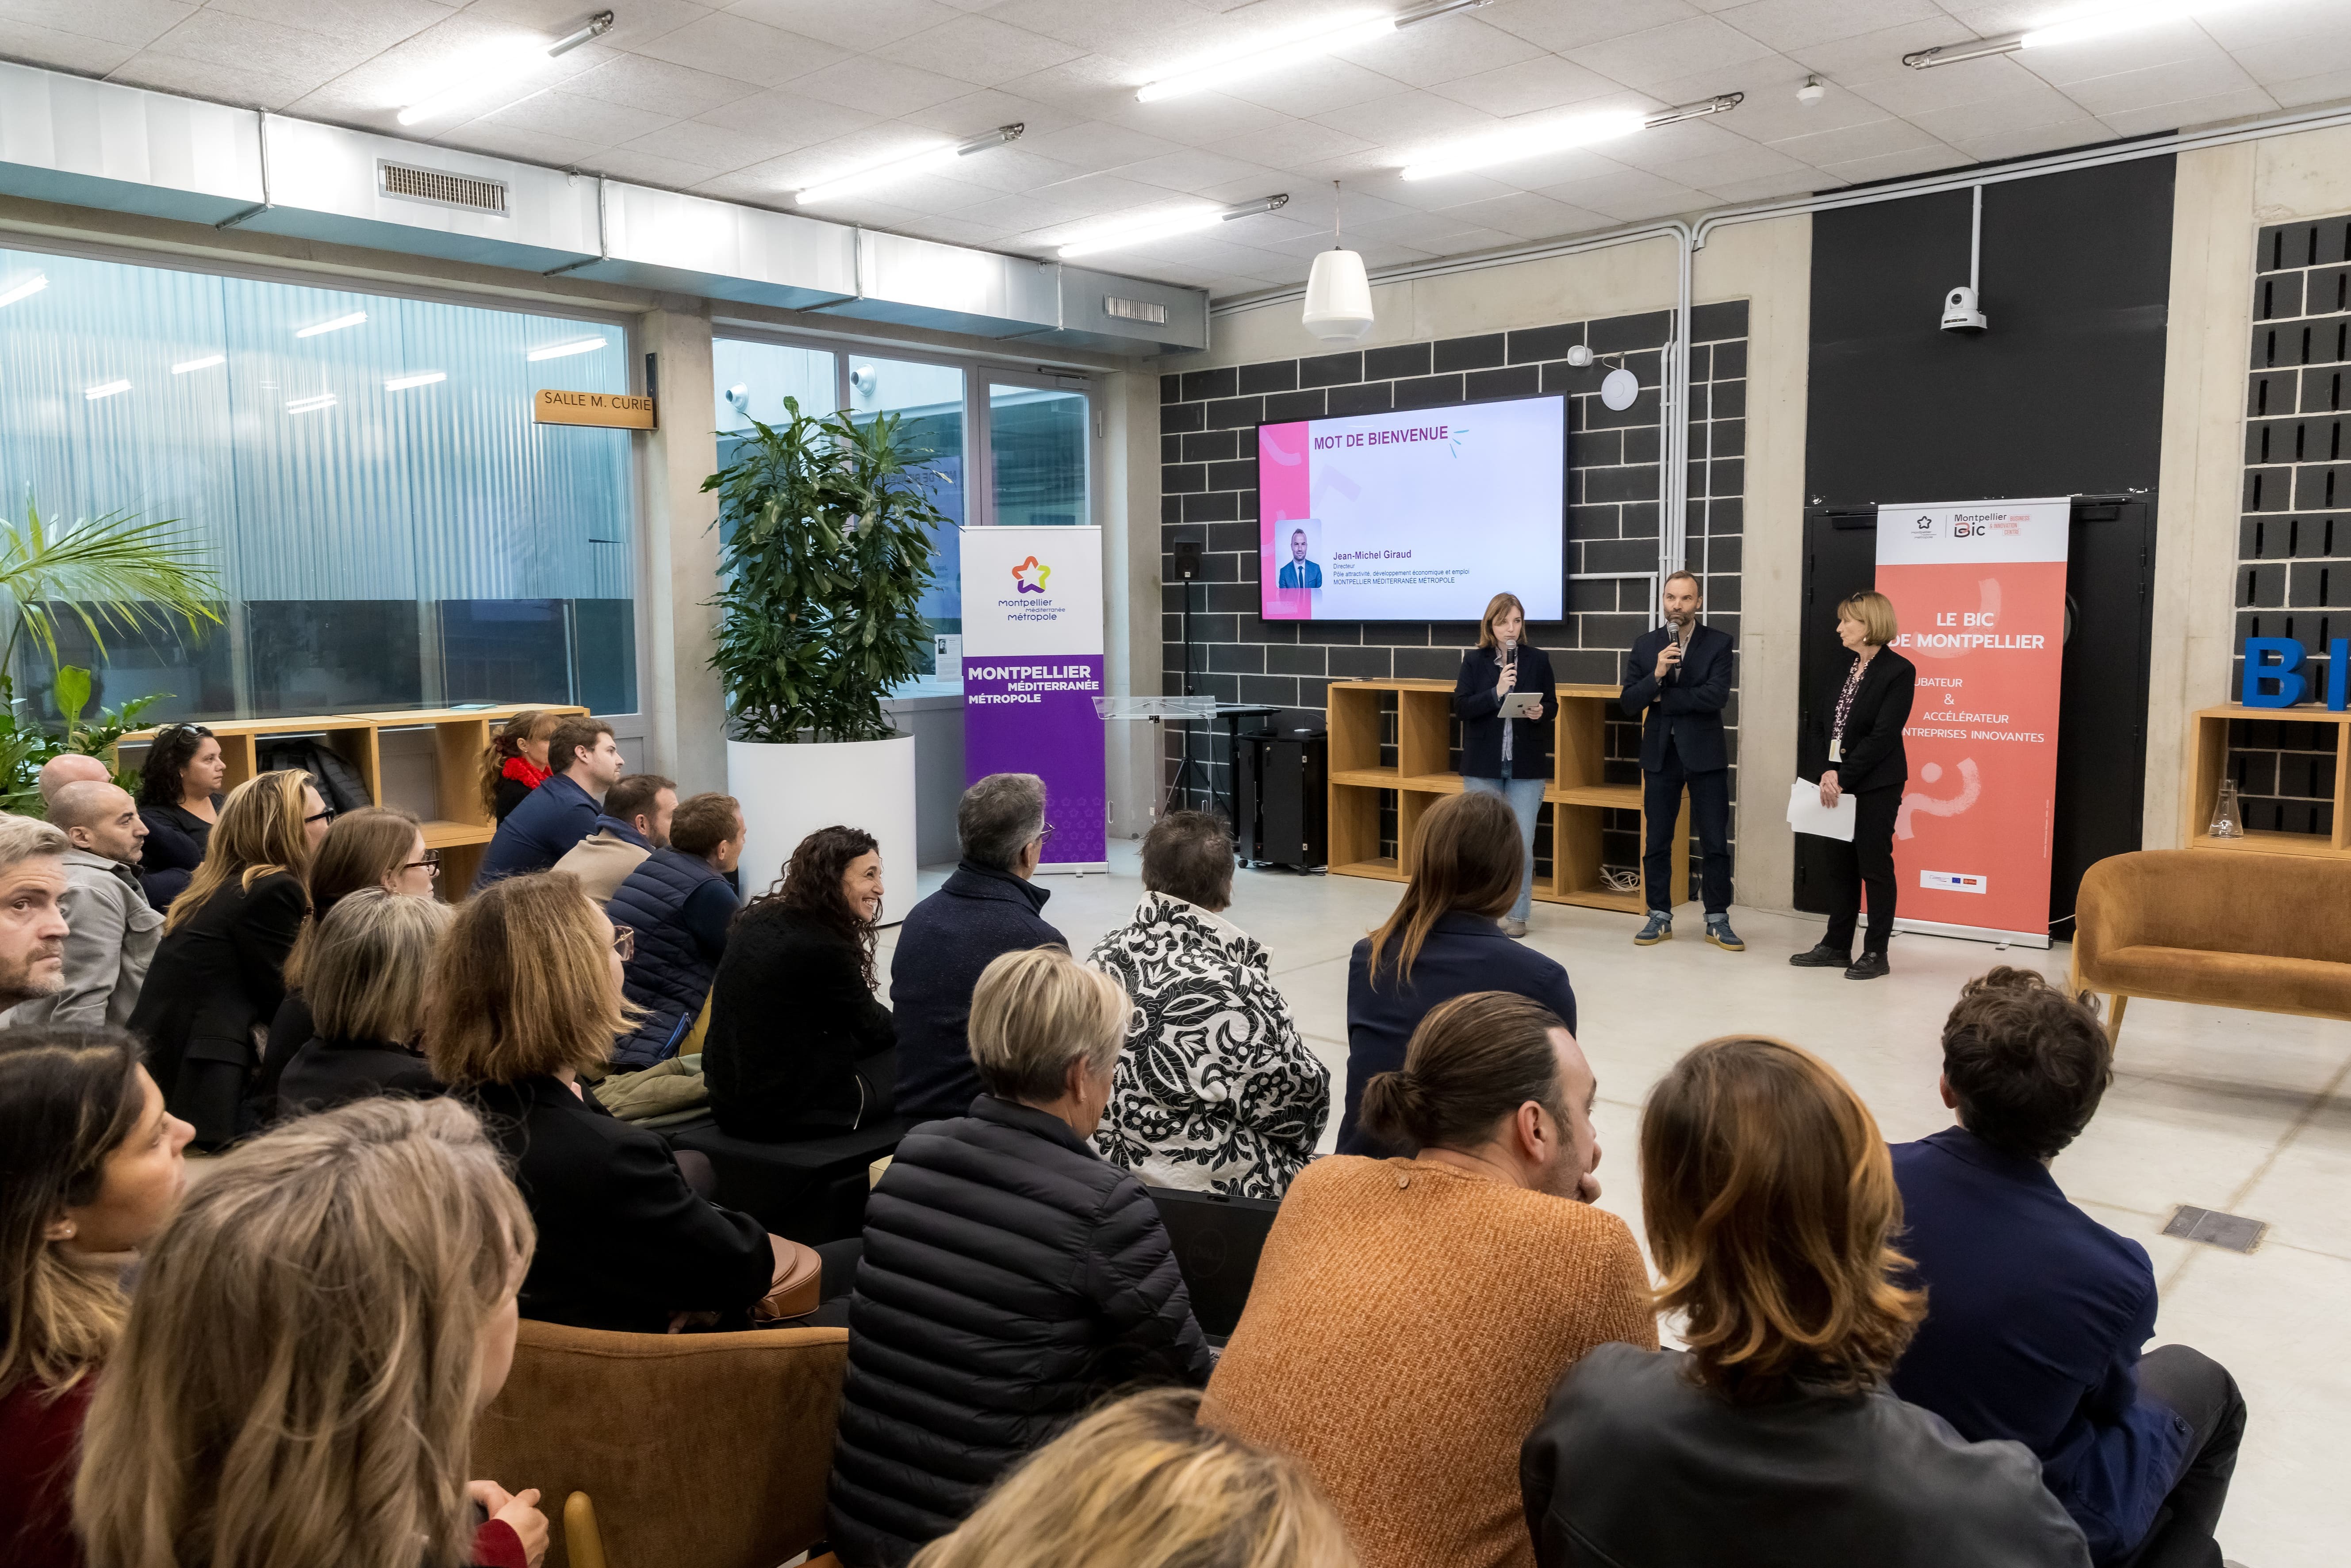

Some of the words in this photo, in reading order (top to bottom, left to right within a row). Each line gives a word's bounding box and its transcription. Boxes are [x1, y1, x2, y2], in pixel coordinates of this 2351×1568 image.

[545, 392, 586, 406] SALLE
[591, 396, 607, 407] M.
[612, 398, 652, 410] CURIE
[1314, 435, 1342, 450] MOT
[1346, 433, 1364, 447] DE
[1369, 426, 1448, 445] BIENVENUE
[1954, 513, 2007, 522] Montpellier
[1333, 551, 1381, 560] Jean-Michel
[1384, 550, 1411, 559] Giraud
[1937, 612, 1957, 626] LE
[1963, 612, 1994, 627] BIC
[1888, 634, 1911, 647] DE
[1917, 634, 2045, 649] MONTPELLIER
[968, 665, 1091, 680] MONTPELLIER
[1008, 679, 1099, 691] MÉDITERRANÉE
[1914, 678, 1963, 687] UBATEUR
[969, 693, 1041, 704] MÉTROPOLE
[1944, 694, 1955, 705] &
[1923, 710, 2009, 724] ACCÉLÉRATEUR
[1902, 727, 1967, 739] NTREPRISES
[1971, 730, 2045, 743] INNOVANTES
